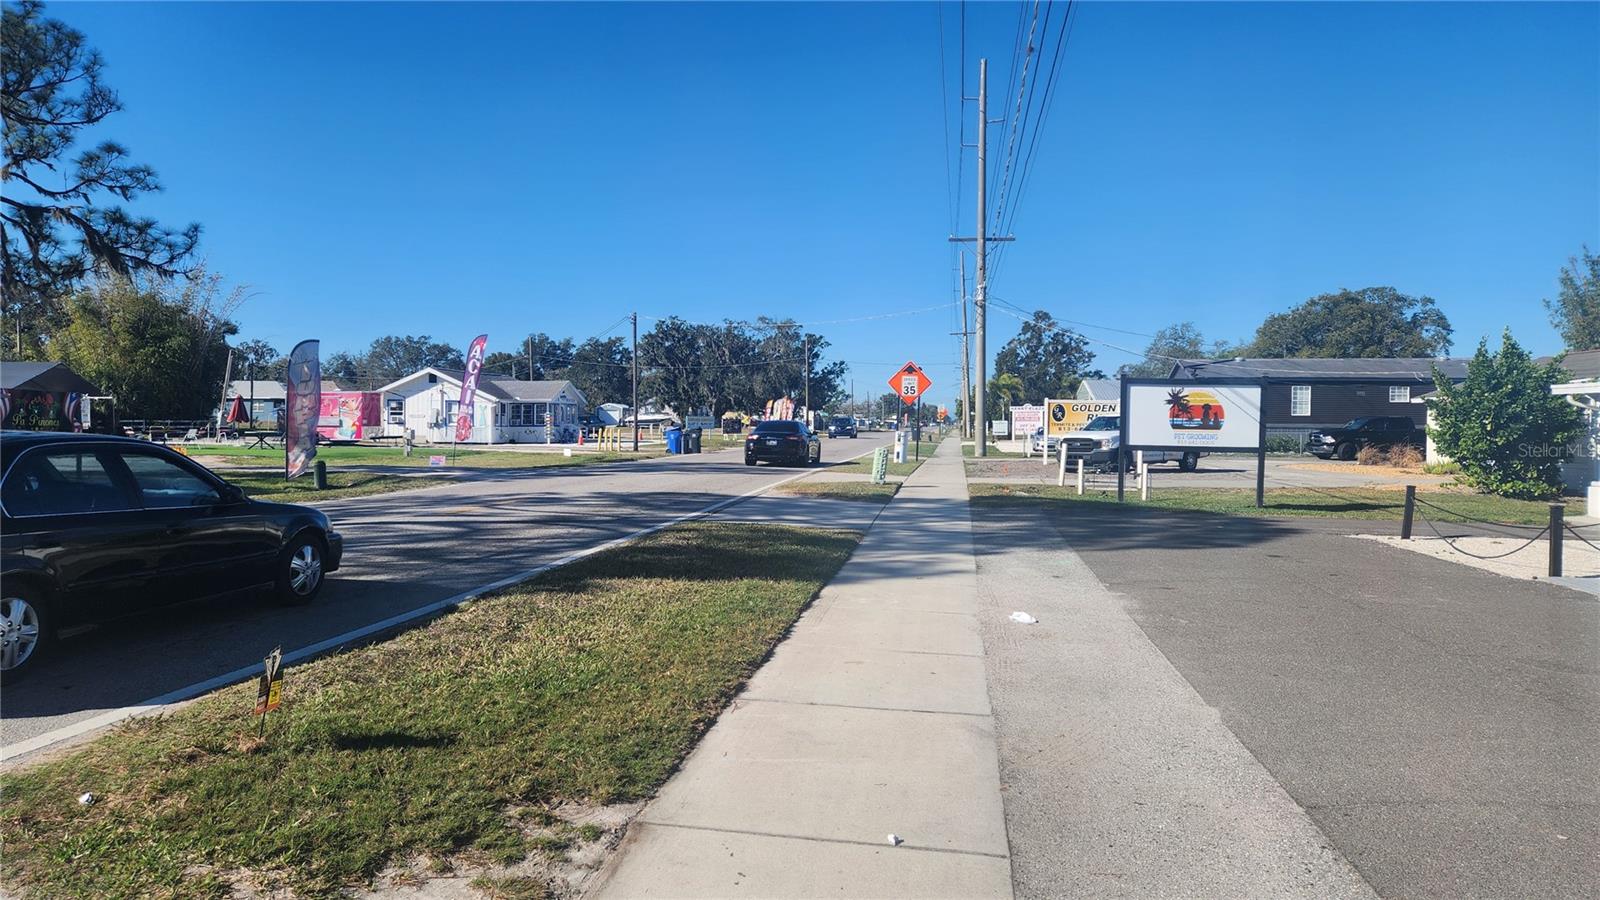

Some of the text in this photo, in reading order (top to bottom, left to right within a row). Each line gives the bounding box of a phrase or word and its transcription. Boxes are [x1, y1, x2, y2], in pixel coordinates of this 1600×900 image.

[464, 344, 481, 404] ACAI
[903, 386, 916, 395] 35
[1071, 404, 1117, 412] GOLDEN
